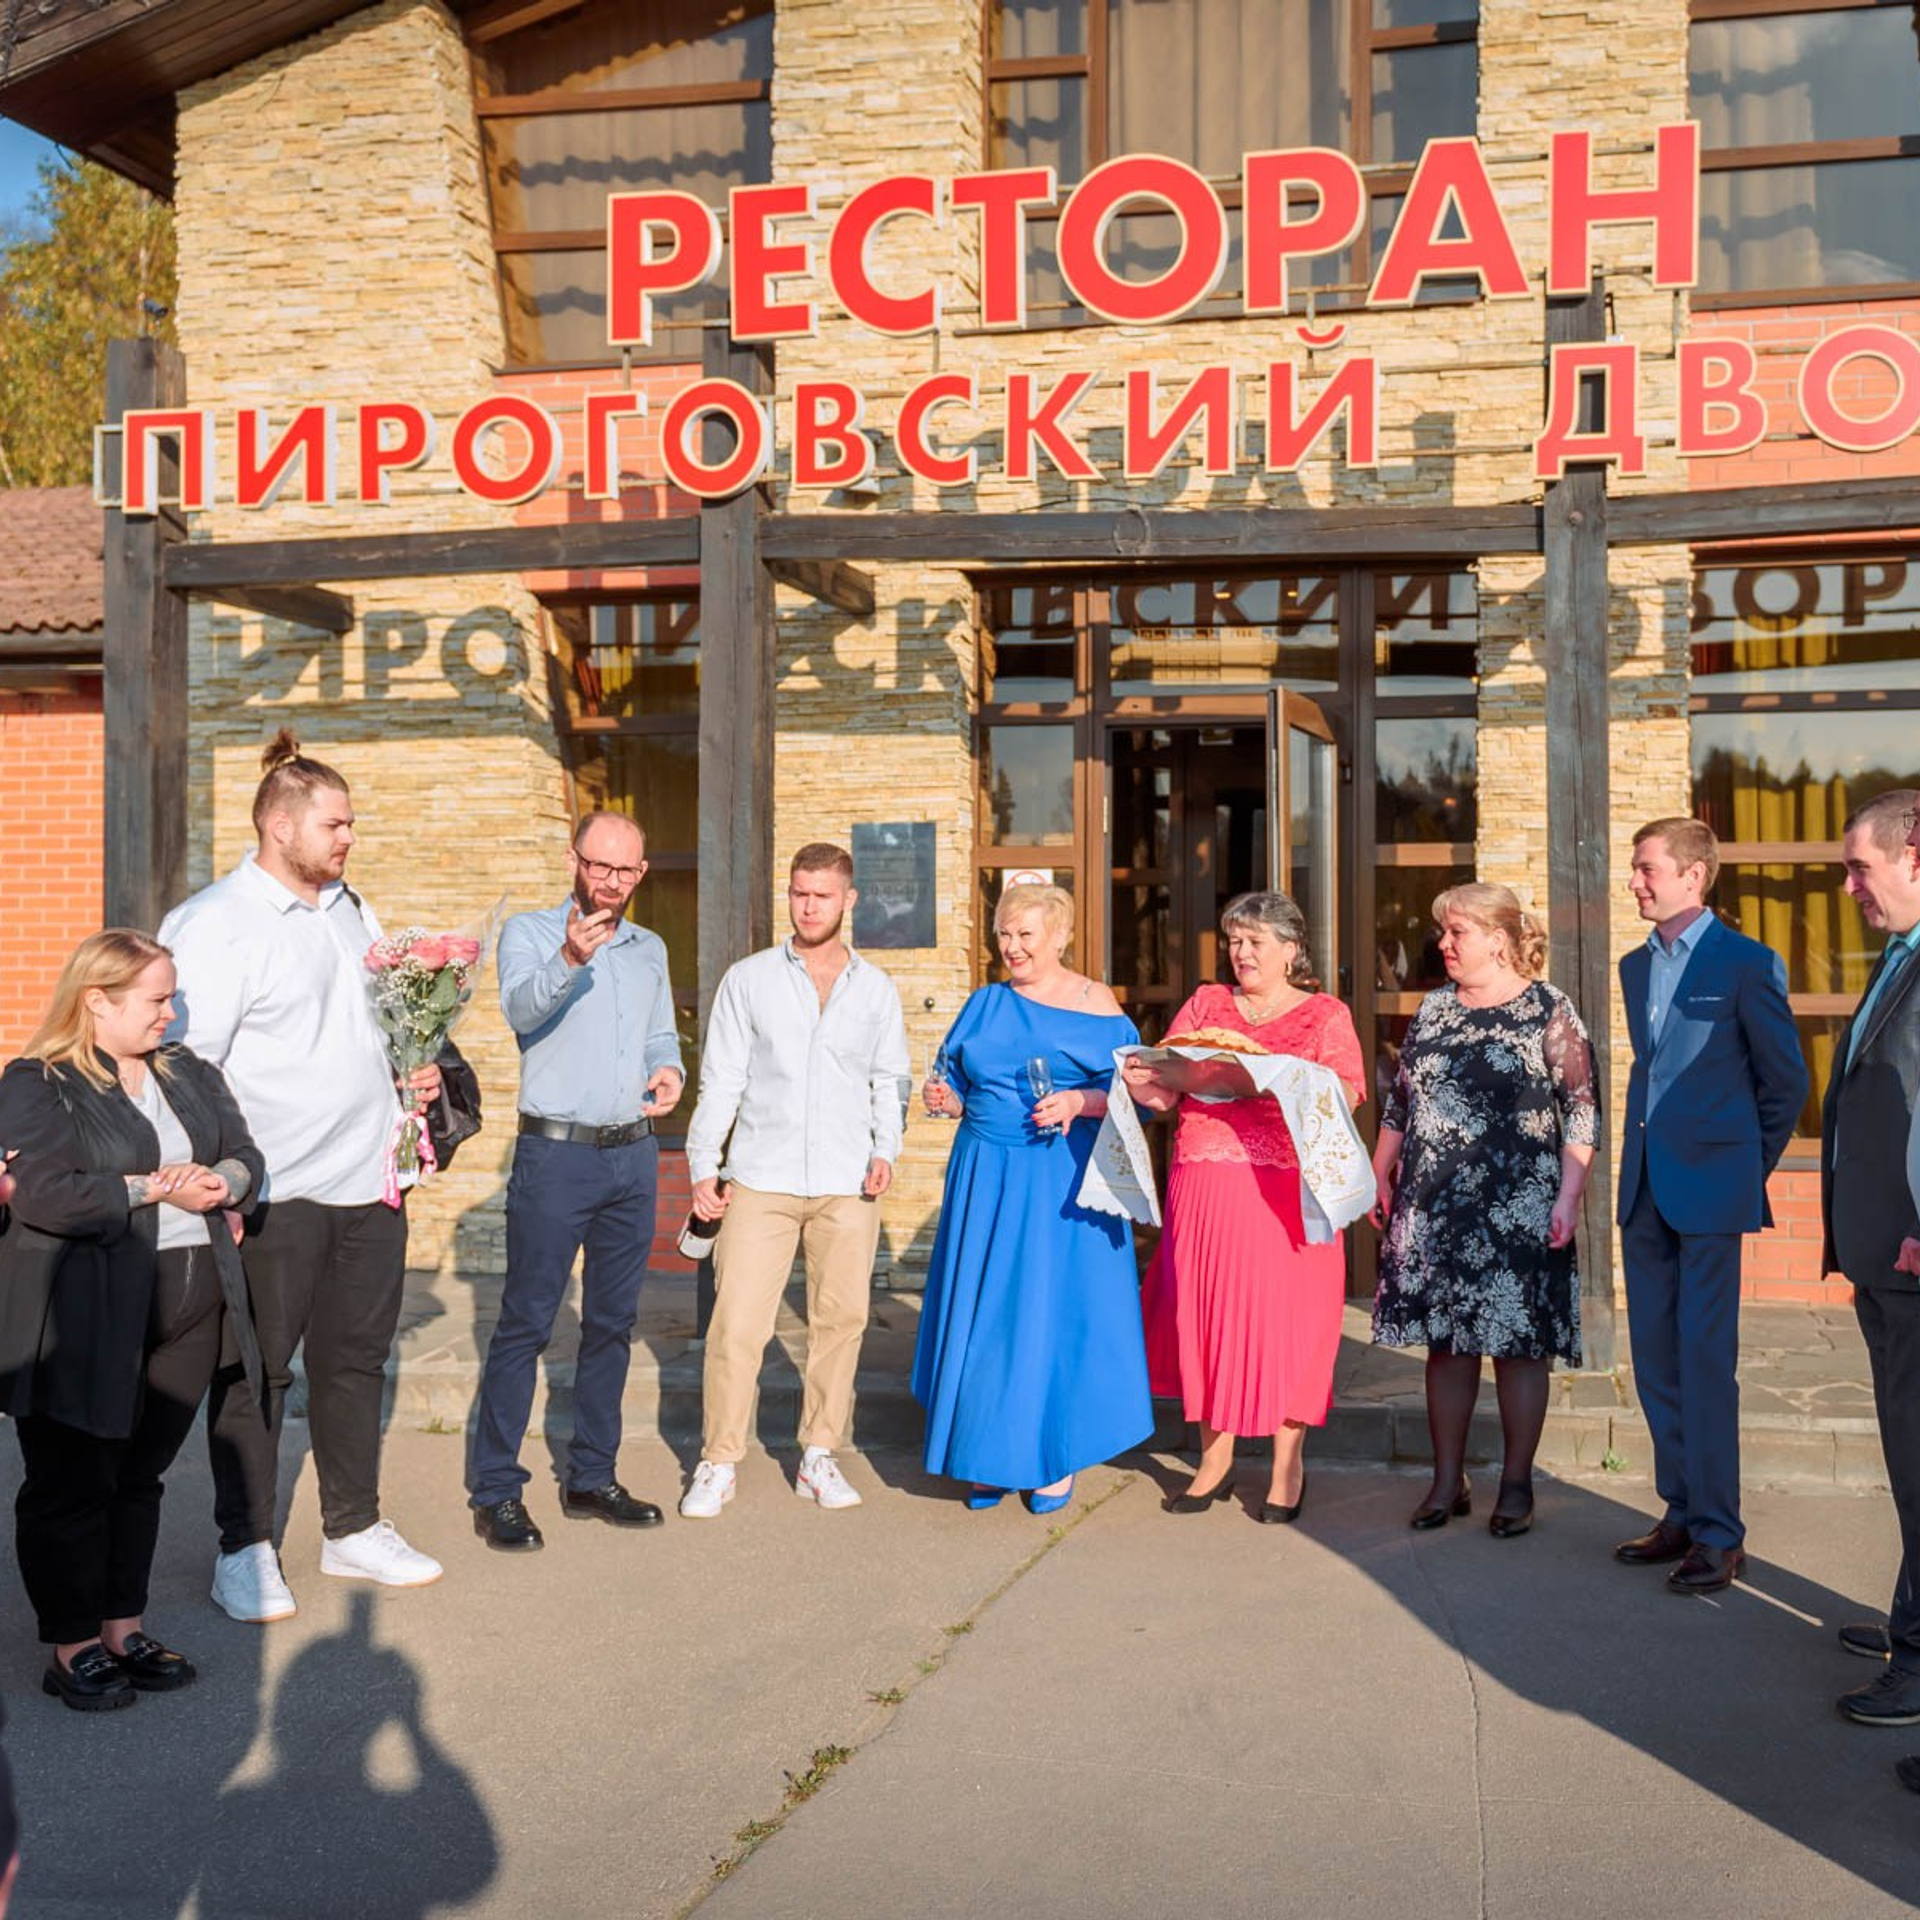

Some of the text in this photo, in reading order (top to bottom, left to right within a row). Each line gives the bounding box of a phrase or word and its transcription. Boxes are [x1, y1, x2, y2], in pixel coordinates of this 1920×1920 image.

[607, 120, 1700, 346] РЕСТОРАН
[120, 323, 1920, 514] ПИРОГОВСКИЙ ДВО
